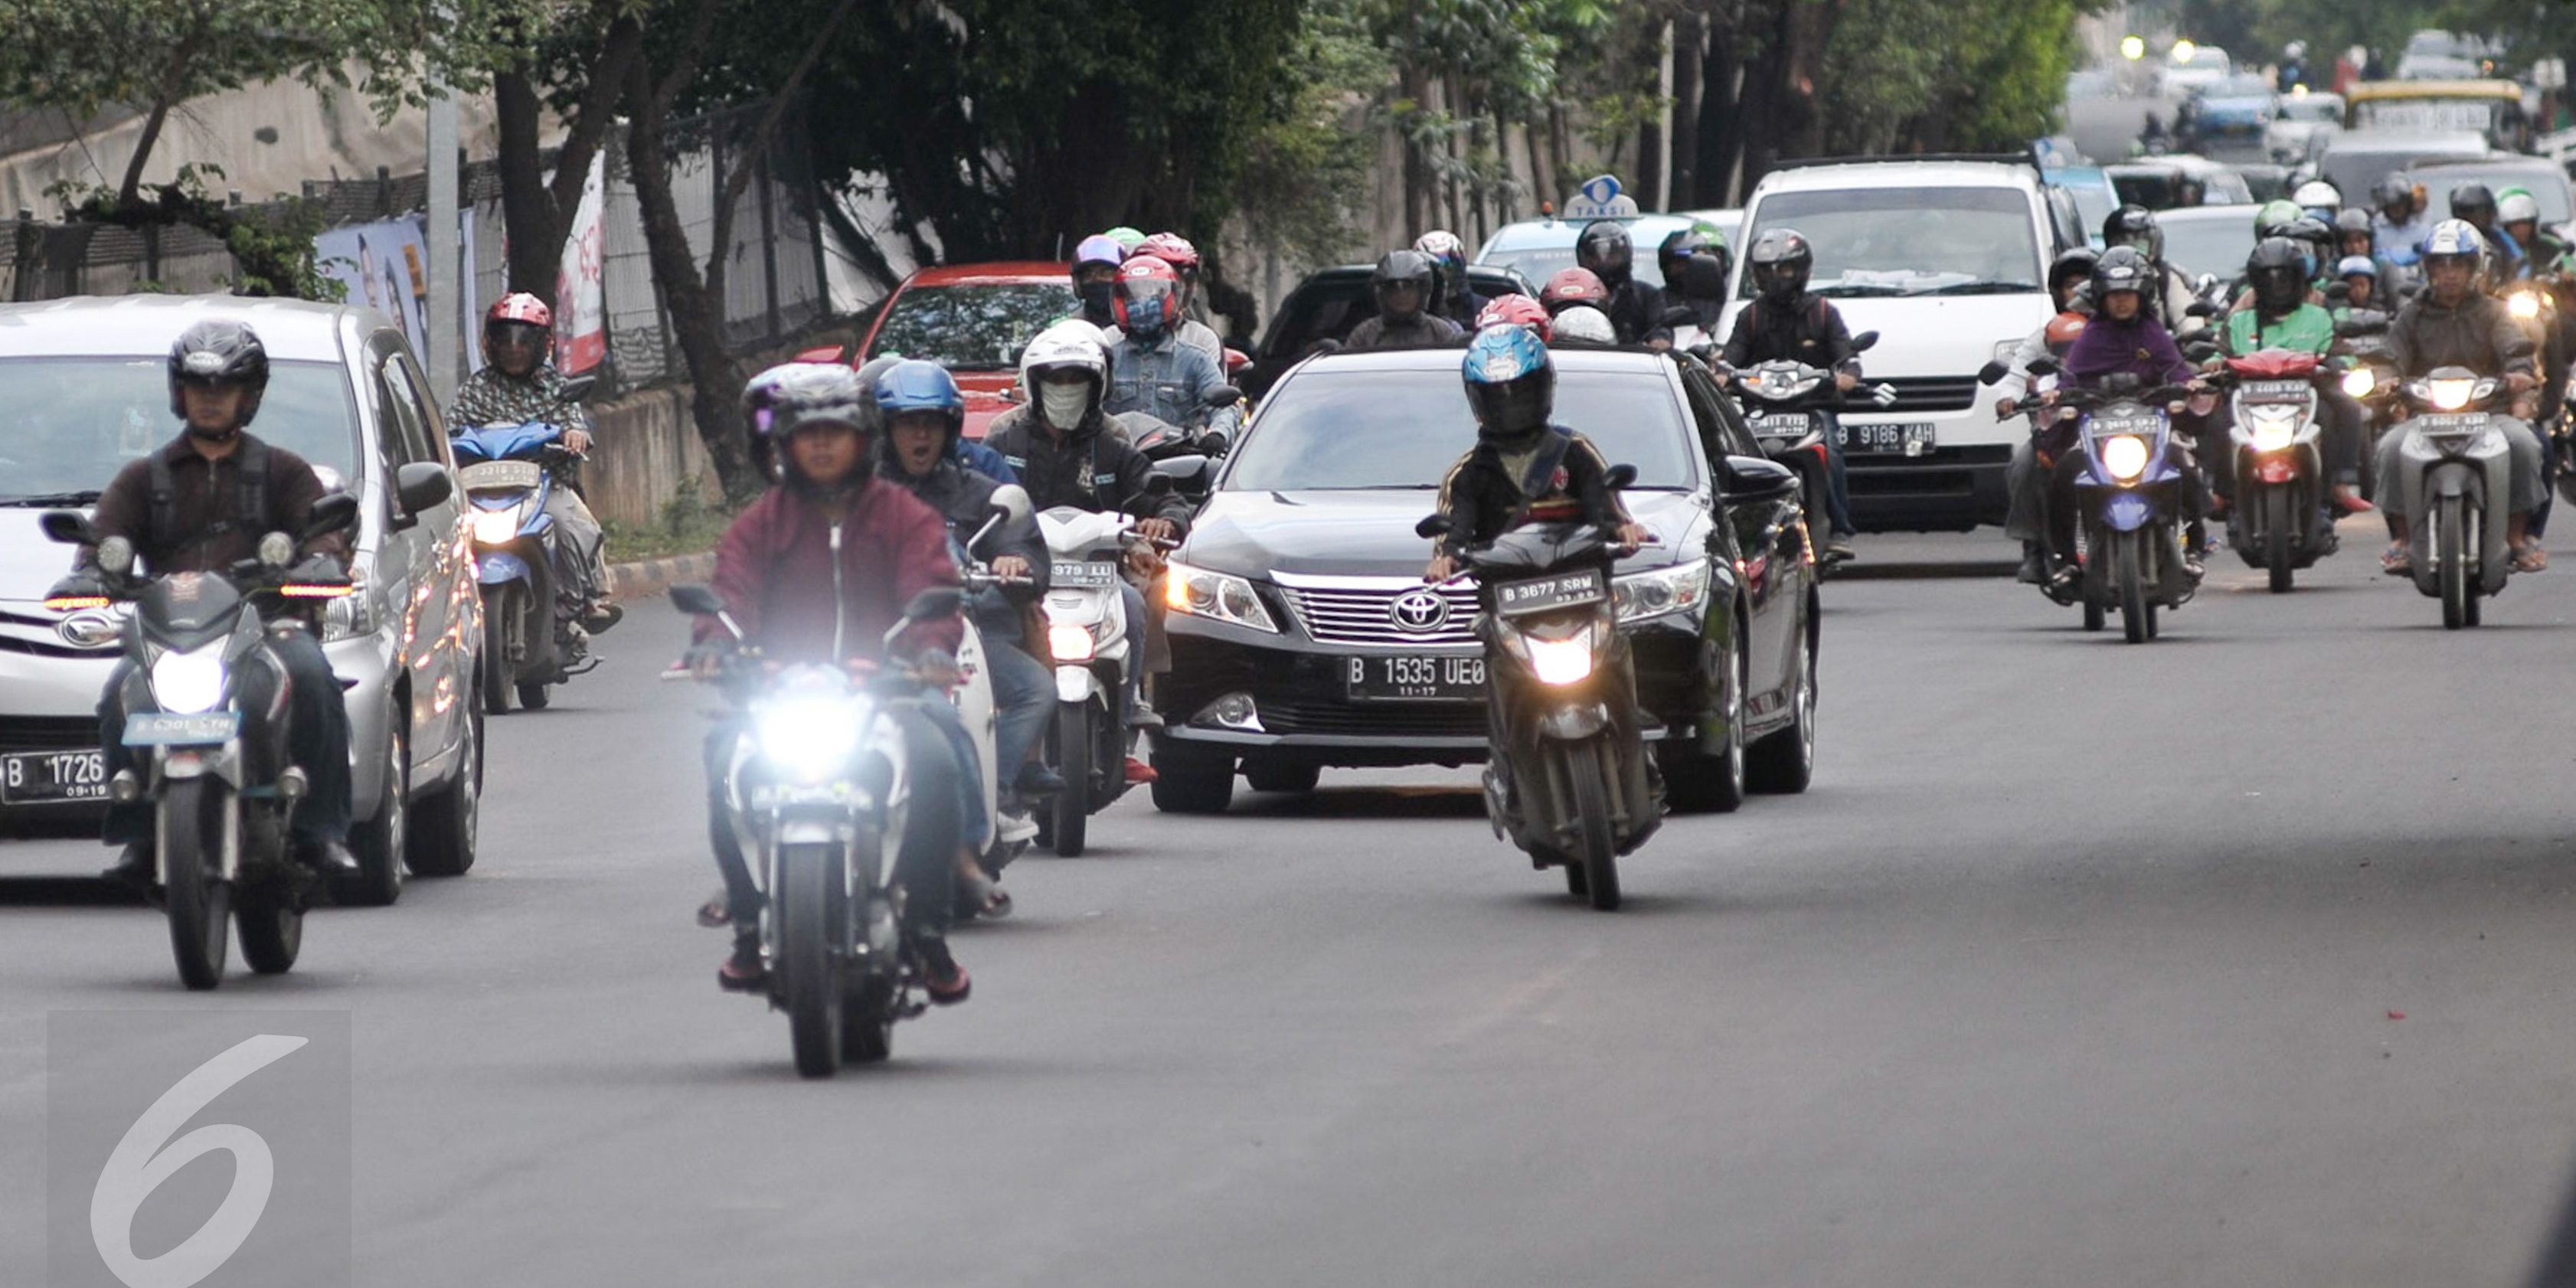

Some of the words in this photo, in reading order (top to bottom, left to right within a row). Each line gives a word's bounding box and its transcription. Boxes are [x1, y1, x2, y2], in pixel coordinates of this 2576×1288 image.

[1576, 206, 1625, 217] TAKSI
[1860, 426, 1899, 443] 9186
[1904, 423, 1934, 443] KAH
[1051, 564, 1083, 576] 979
[1504, 587, 1516, 602] B
[1519, 581, 1556, 600] 3677
[1563, 576, 1593, 592] SRW
[1351, 658, 1364, 684] B
[1385, 658, 1437, 685] 1535
[8, 758, 23, 788] B
[51, 754, 104, 785] 1726
